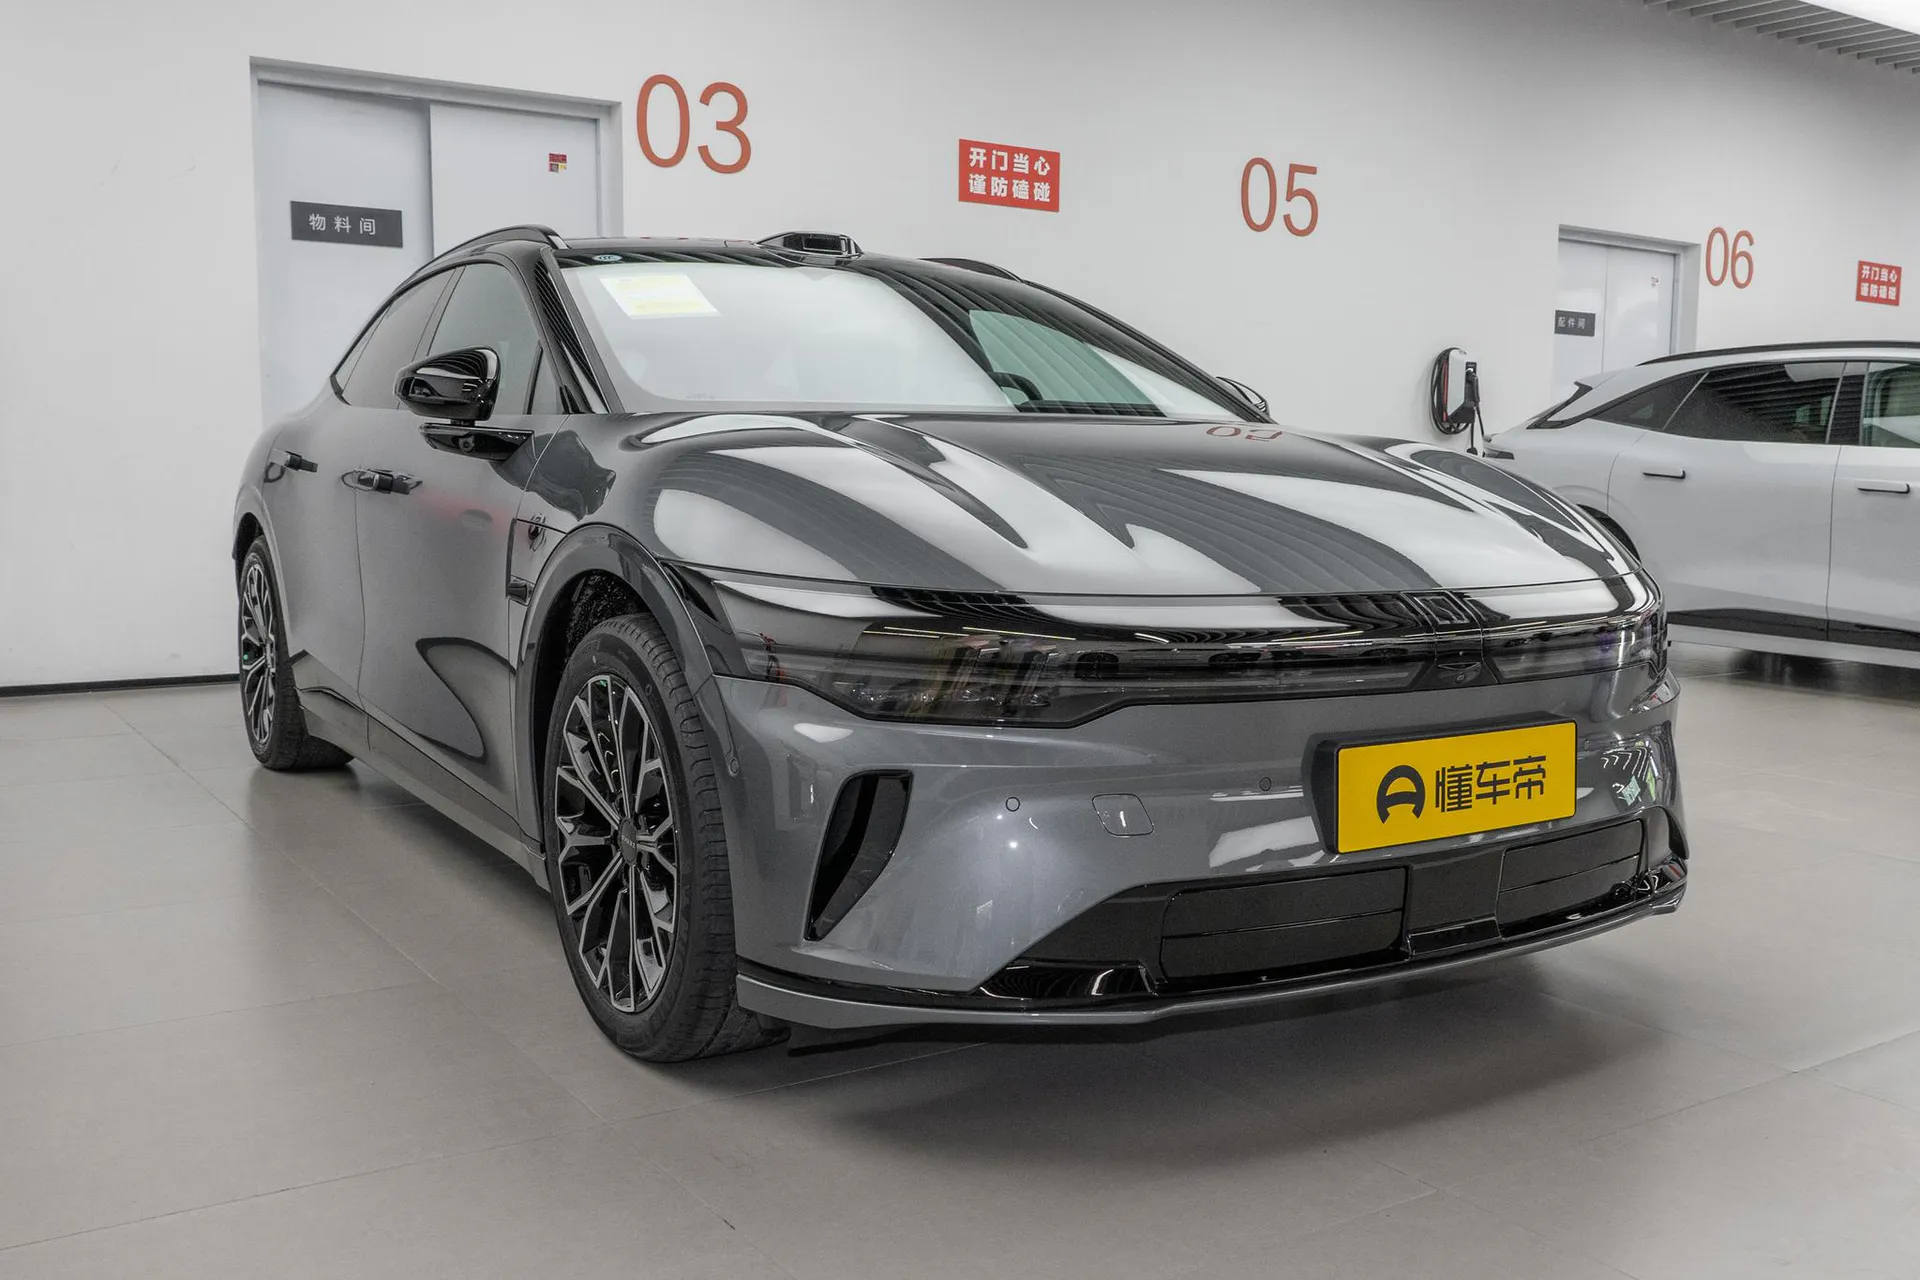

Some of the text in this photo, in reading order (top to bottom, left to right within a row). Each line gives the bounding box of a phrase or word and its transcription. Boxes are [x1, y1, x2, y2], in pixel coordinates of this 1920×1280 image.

[636, 74, 751, 174] 03
[968, 146, 1051, 176] 开门当心
[968, 173, 1051, 203] 谨防磕碰
[308, 212, 376, 235] 物料间
[1241, 157, 1319, 237] 05
[1705, 226, 1754, 289] 06
[1435, 755, 1547, 813] 懂车帝
